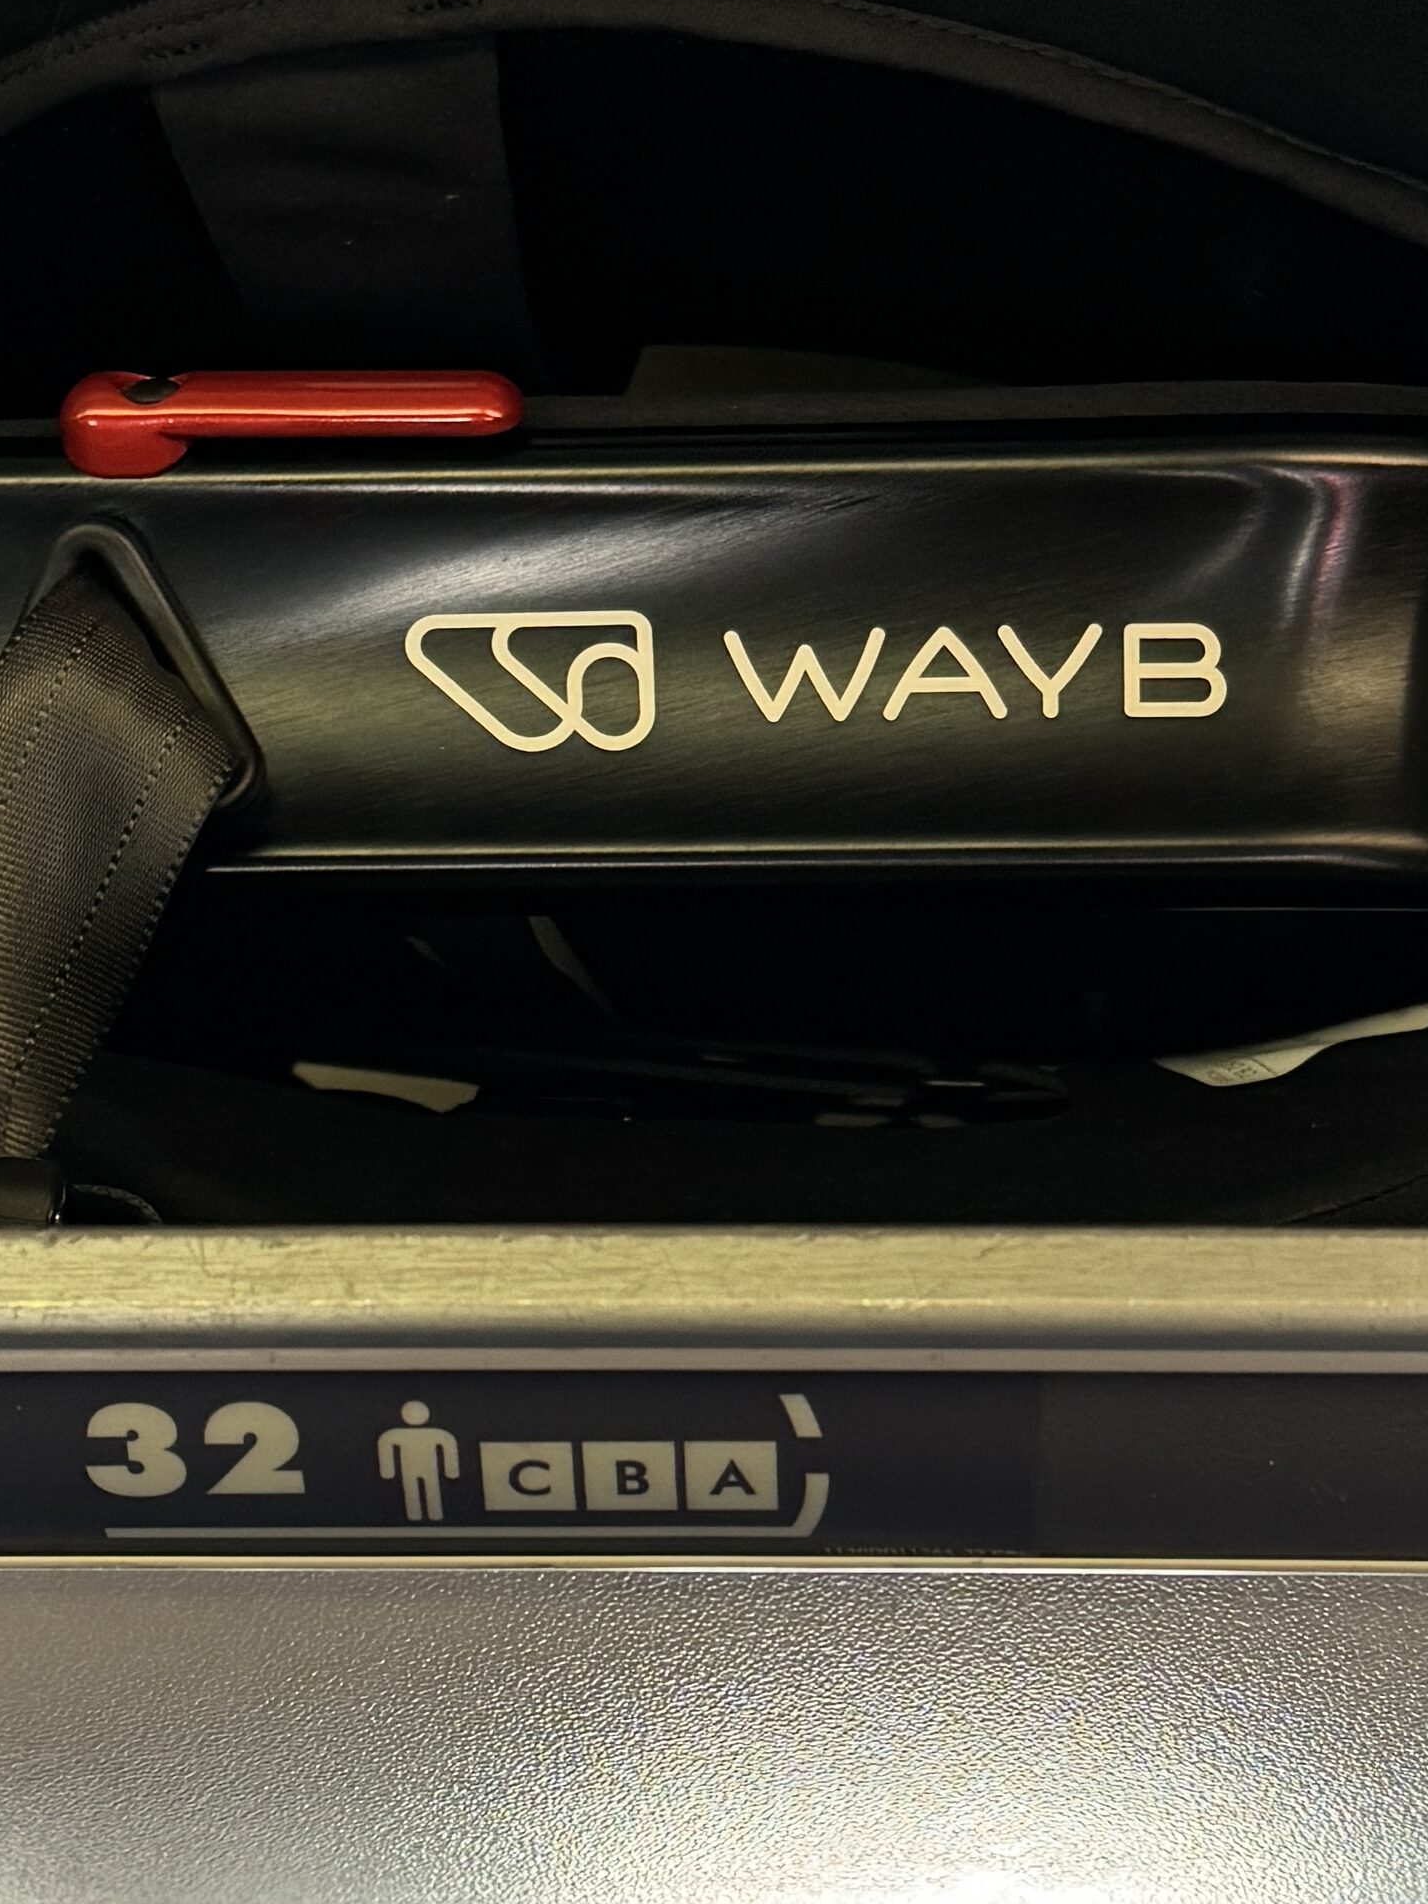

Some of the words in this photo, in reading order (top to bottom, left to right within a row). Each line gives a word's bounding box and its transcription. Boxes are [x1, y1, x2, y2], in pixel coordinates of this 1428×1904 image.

[723, 622, 1228, 723] WAYB
[86, 1401, 305, 1497] 32
[508, 1459, 552, 1497] C
[615, 1459, 650, 1496] B
[709, 1459, 757, 1496] A
